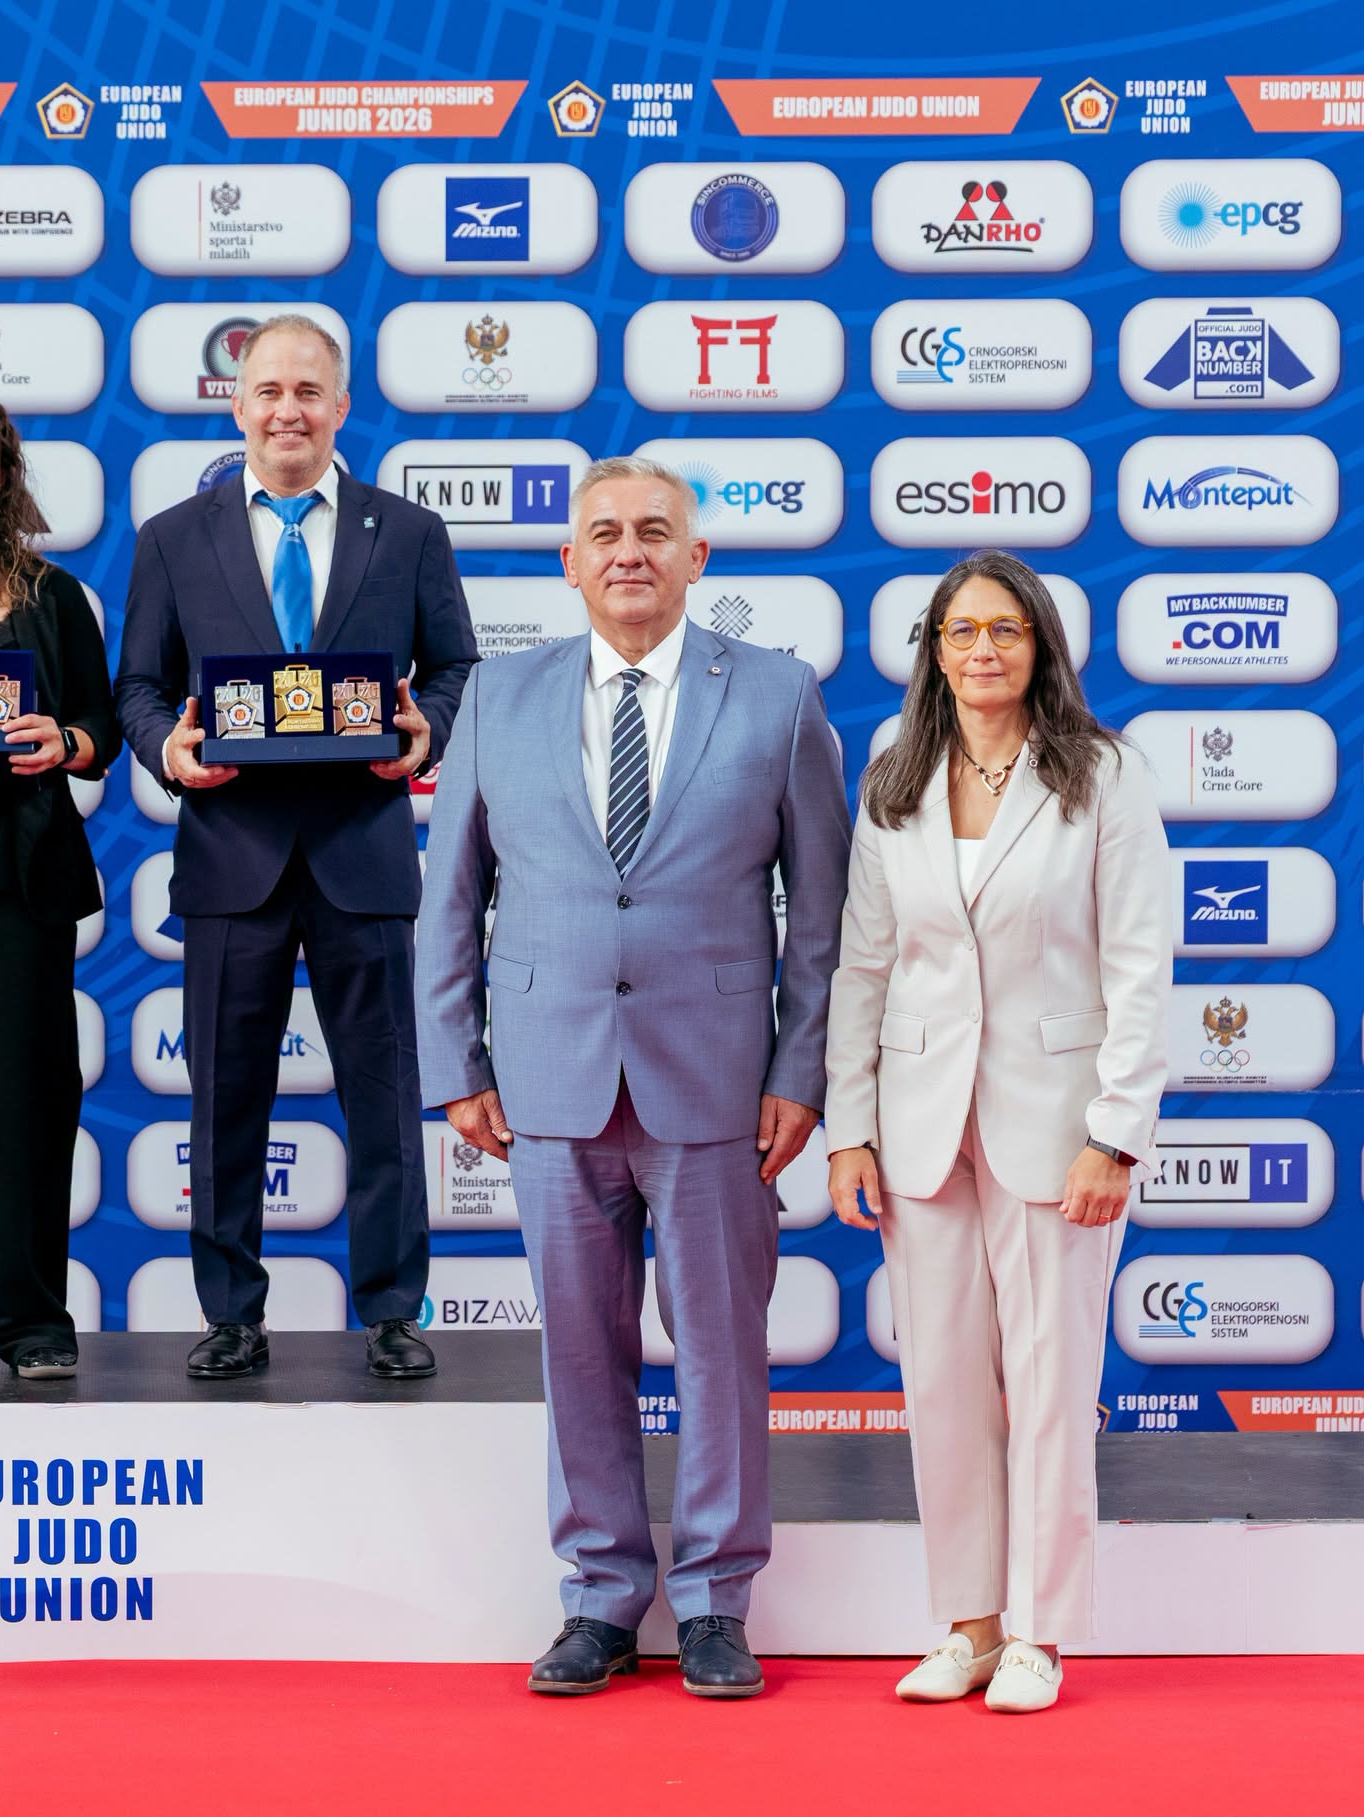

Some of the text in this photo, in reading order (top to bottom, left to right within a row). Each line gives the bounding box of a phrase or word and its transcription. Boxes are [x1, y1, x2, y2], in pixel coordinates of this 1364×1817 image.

[100, 85, 182, 102] EUROPEAN
[234, 86, 494, 107] EUROPEAN JUDO CHAMPIONSHIPS
[612, 83, 693, 101] EUROPEAN
[1125, 80, 1207, 97] EUROPEAN
[1260, 81, 1341, 100] EUROPEAN
[121, 105, 161, 121] JUDO
[633, 102, 673, 119] JUDO
[773, 96, 980, 118] EUROPEAN JUDO UNION
[1146, 99, 1186, 115] JUDO
[296, 109, 432, 132] JUNIOR 2026
[627, 120, 678, 137] UNION
[1141, 117, 1191, 133] UNION
[116, 122, 166, 139] UNION
[695, 174, 775, 208] SINCOMMERCE
[1220, 201, 1303, 234] epcg
[209, 221, 283, 232] Ministarstvo
[209, 236, 254, 248] sporta i
[209, 248, 250, 260] mladih
[969, 347, 1036, 356] CRNOGORSKI
[1196, 340, 1262, 361] BACK
[969, 360, 1067, 370] ELEKTROPRENOSNI
[1196, 361, 1262, 374] NUMBER
[1, 373, 31, 385] Gore
[969, 373, 1006, 383] SISTEM
[690, 389, 778, 398] FIGHTING FILMS
[1225, 381, 1259, 394] .com
[417, 480, 555, 507] KNOW IT
[722, 481, 806, 514] epcg
[896, 471, 1065, 514] essimo
[1142, 474, 1295, 511] Monteput
[475, 624, 542, 634] CRNOGORSKI
[1172, 621, 1280, 649] .COM
[1166, 656, 1288, 665] WE PERSONALIZE ATHLETES
[1202, 767, 1234, 777] Vlada
[1202, 780, 1263, 791] Crne Gore
[1264, 1159, 1292, 1184] IT
[452, 1176, 511, 1187] Ministarst
[452, 1189, 496, 1202] sporta i
[452, 1203, 492, 1214] mladih
[1211, 1302, 1279, 1311] CRNOGORSKI
[1211, 1315, 1309, 1325] ELEKTROPRENOSNI
[1211, 1328, 1248, 1338] SISTEM
[1117, 1395, 1198, 1411] EUROPEAN
[1252, 1397, 1333, 1414] EUROPEAN
[768, 1410, 861, 1430] EUROPEAN
[1138, 1413, 1178, 1429] JUDO
[14, 1518, 137, 1565] JUDO
[0, 1577, 153, 1622] UNION
